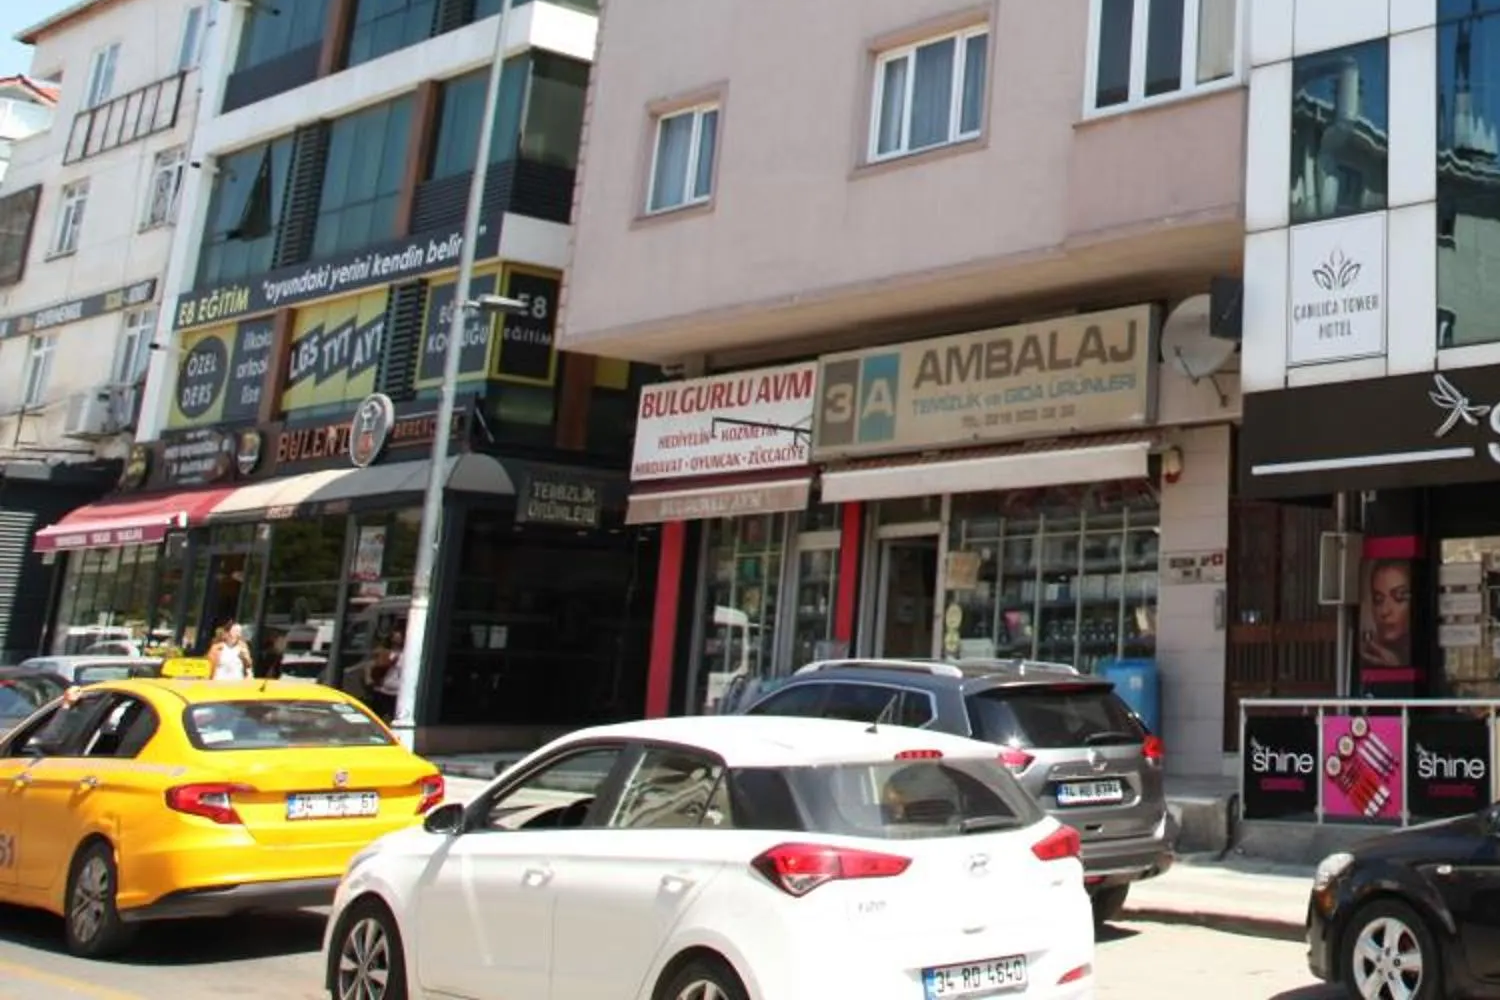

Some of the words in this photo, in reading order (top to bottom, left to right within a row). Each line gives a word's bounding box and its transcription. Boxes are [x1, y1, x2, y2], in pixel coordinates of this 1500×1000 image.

[373, 244, 423, 277] kendin
[290, 333, 319, 380] LGS
[322, 326, 354, 374] TYT
[351, 321, 385, 371] AYT
[914, 320, 1137, 389] AMBALAJ
[182, 383, 214, 408] DERS
[641, 378, 751, 420] BULGURLU
[755, 369, 813, 404] AVM
[1252, 747, 1314, 774] shine
[1417, 752, 1485, 779] shine
[935, 970, 956, 993] 34
